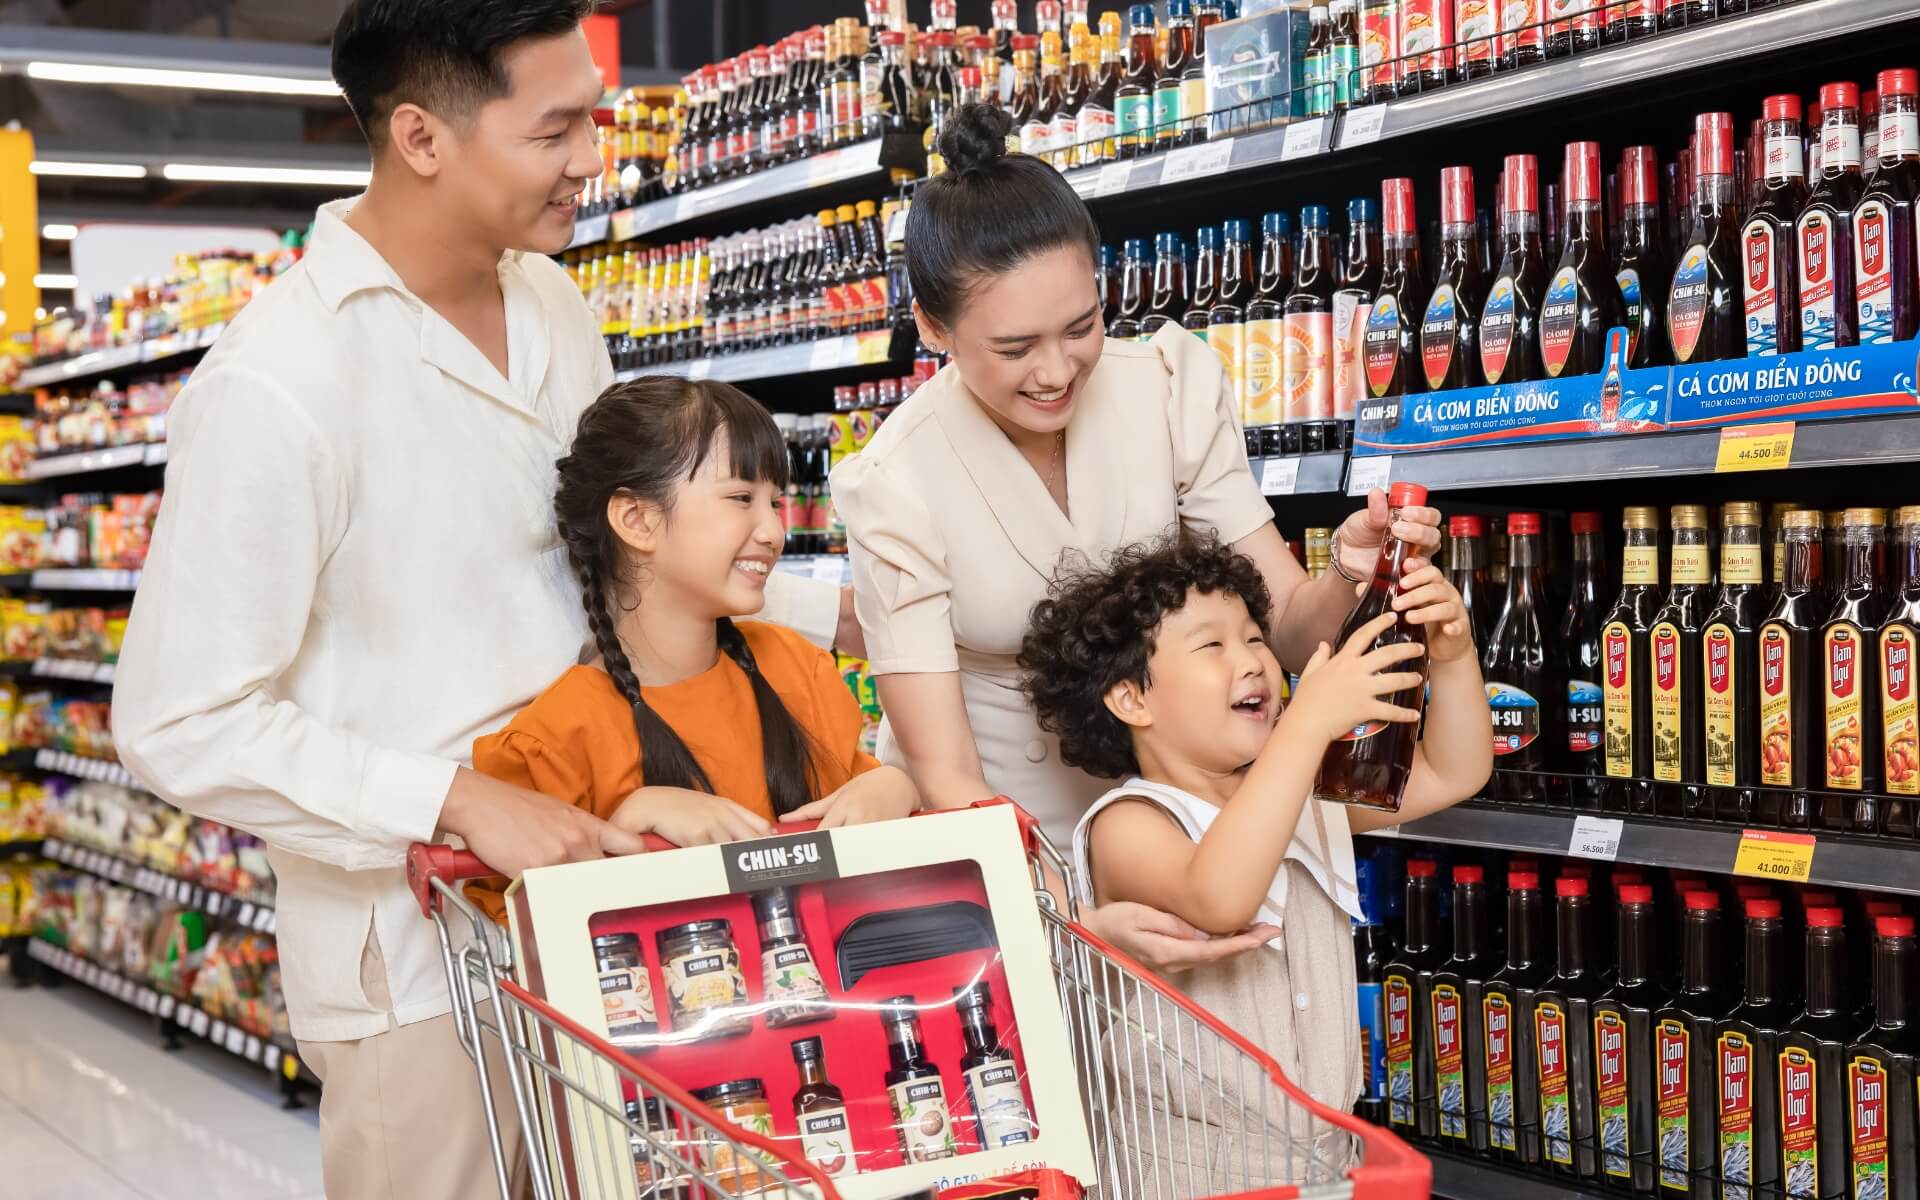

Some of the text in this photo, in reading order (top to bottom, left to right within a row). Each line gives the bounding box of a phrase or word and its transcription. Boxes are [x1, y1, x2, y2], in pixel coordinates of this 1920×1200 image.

[1807, 231, 1824, 249] Nam
[1863, 223, 1880, 240] Nam
[1751, 240, 1766, 257] Nam
[1673, 284, 1705, 299] CHIN-SU
[1483, 313, 1512, 326] CHIN-SU
[1545, 304, 1575, 317] CHIN-SU
[1367, 328, 1397, 341] CHIN-SU
[1424, 320, 1453, 333] CHIN-SU
[1678, 358, 1862, 398] CÁ CƠM BIỂN ĐÔNG
[1361, 404, 1399, 421] CHIN-SU
[1414, 388, 1559, 423] CÁ CƠM BIỂN ĐÔNG
[1738, 447, 1771, 460] 44.500
[1609, 640, 1624, 658] Nam
[1658, 642, 1673, 658] Nam
[1712, 643, 1727, 661] Nam
[1766, 645, 1781, 662] Nam
[1834, 645, 1851, 662] Nam
[1889, 647, 1906, 665] Nam
[1491, 710, 1523, 726] N-SU
[738, 842, 818, 872] CHIN-SU
[1582, 844, 1604, 854] 56.500
[1757, 862, 1790, 875] 41.000
[688, 958, 719, 971] CHIN-SU
[600, 976, 628, 988] HIN-SU
[1390, 993, 1406, 1013] Nam
[1437, 1002, 1456, 1023] Nam
[1489, 1011, 1506, 1032] Nam
[1541, 1020, 1560, 1042] Nam
[1602, 1029, 1621, 1050] Nam
[1663, 1038, 1683, 1061] Nam
[1725, 1051, 1746, 1074] Nam
[1663, 1062, 1680, 1094] Ngư
[1787, 1067, 1809, 1091] Nam
[1725, 1076, 1743, 1109] Ngư
[1857, 1077, 1880, 1102] Nam
[1788, 1093, 1807, 1126] Ngư
[810, 1117, 841, 1130] CHIN-SU
[1858, 1104, 1878, 1138] Ngư
